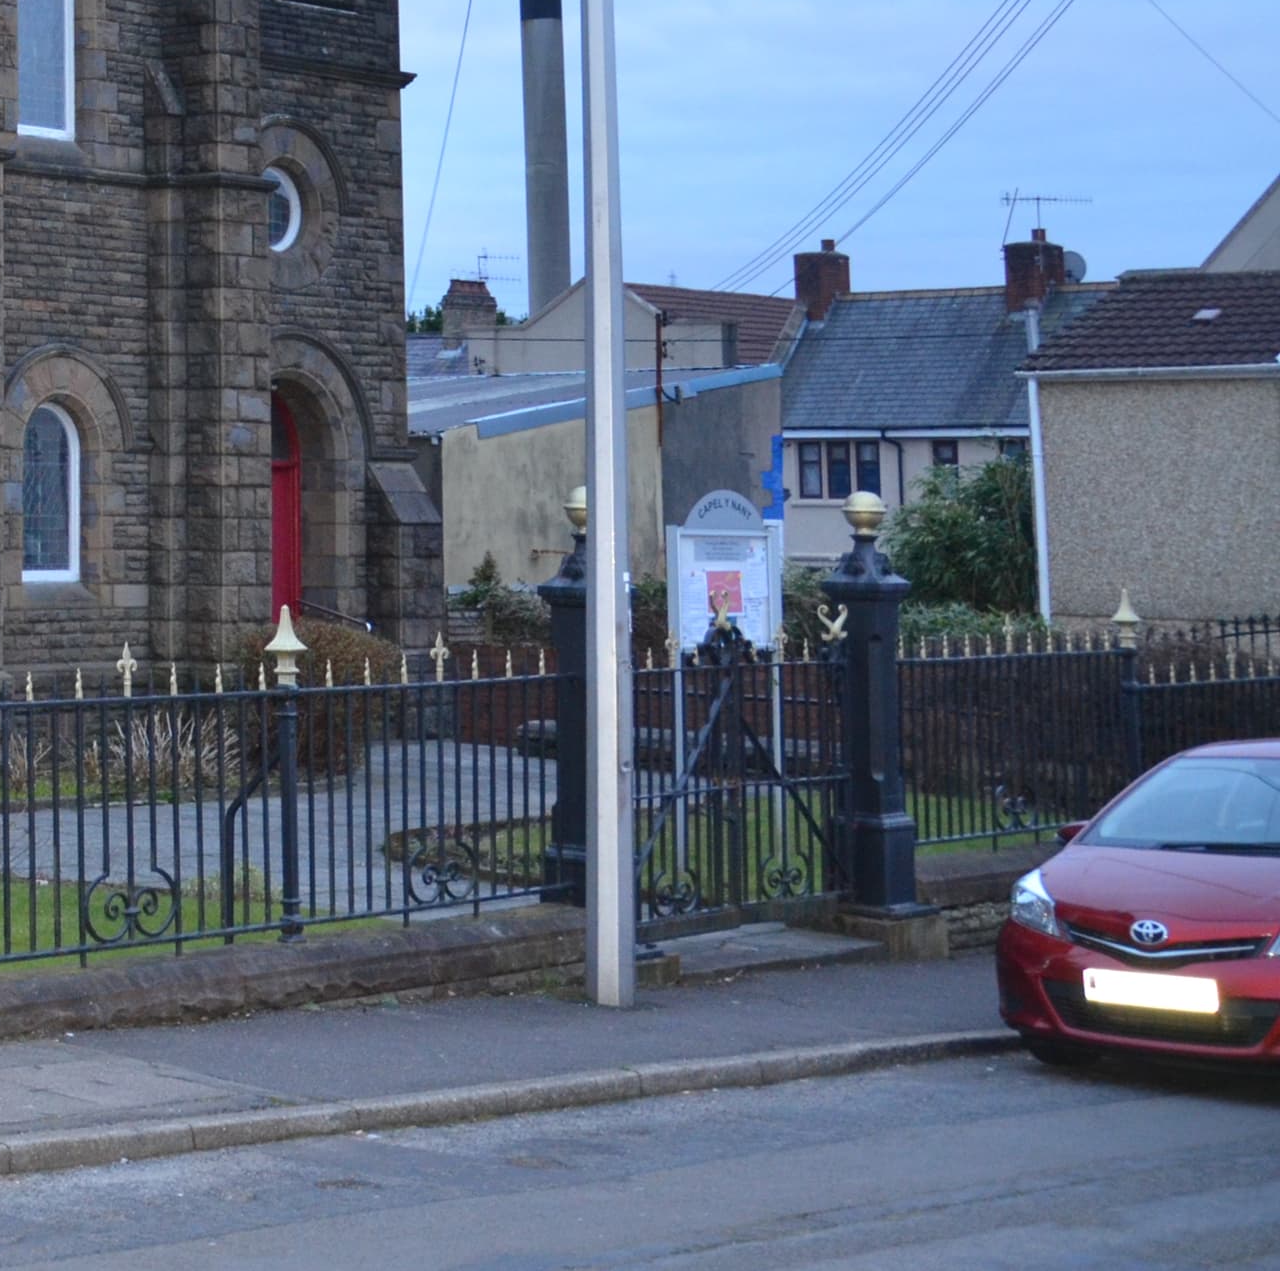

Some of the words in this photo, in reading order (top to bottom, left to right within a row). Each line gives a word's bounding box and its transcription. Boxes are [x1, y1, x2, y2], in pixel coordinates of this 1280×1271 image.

[698, 498, 722, 519] CAPEL
[724, 498, 730, 507] Y
[731, 500, 752, 520] NANT
